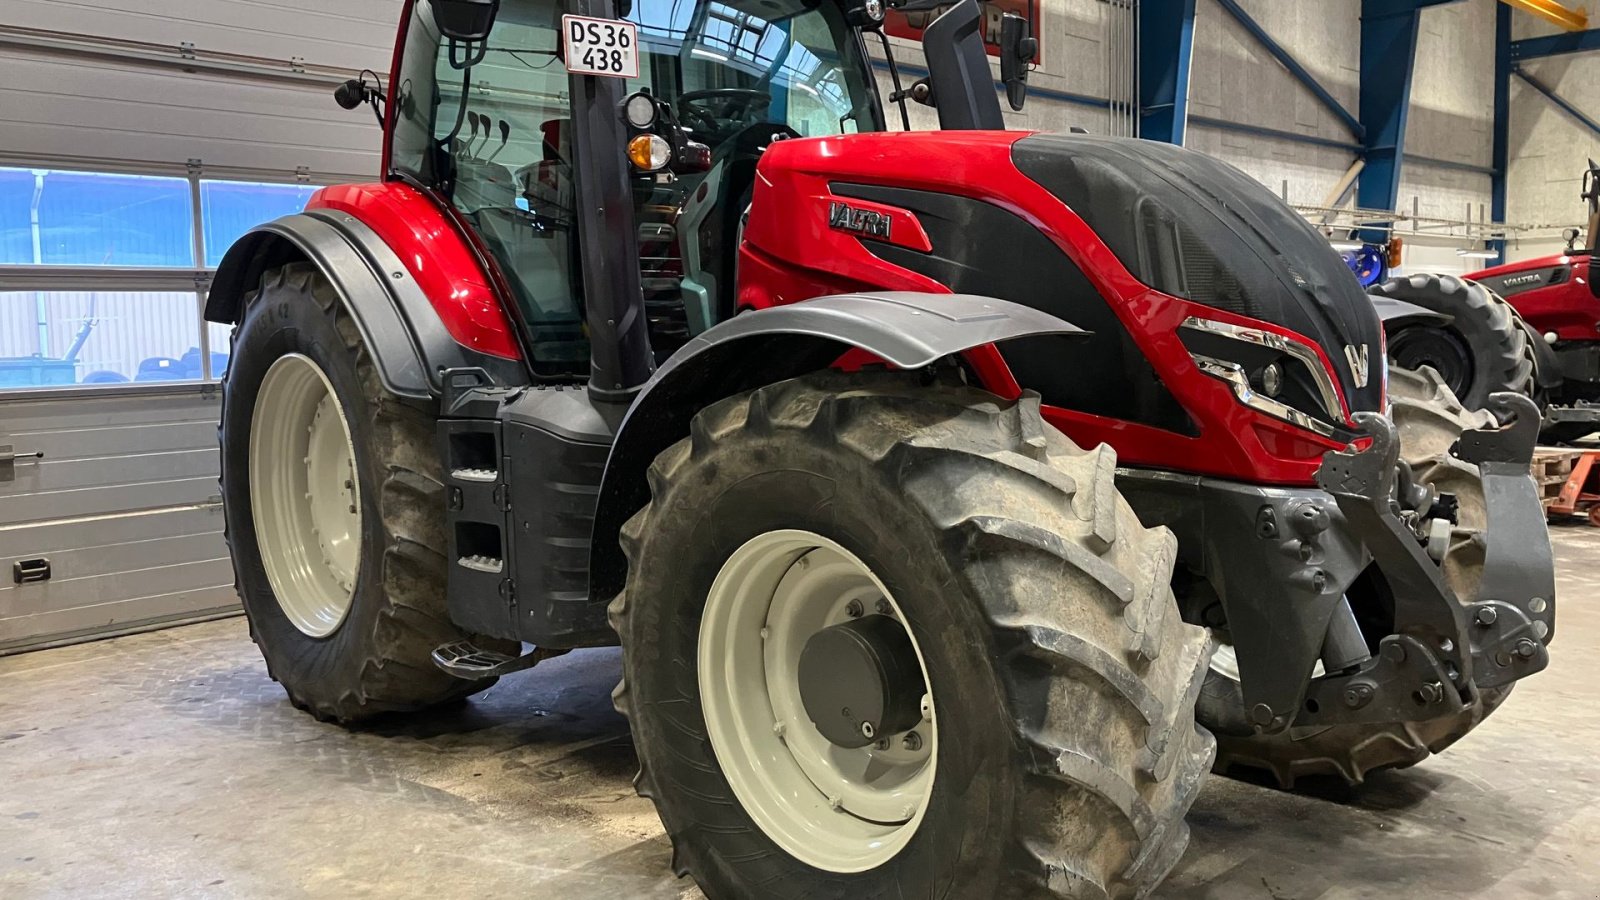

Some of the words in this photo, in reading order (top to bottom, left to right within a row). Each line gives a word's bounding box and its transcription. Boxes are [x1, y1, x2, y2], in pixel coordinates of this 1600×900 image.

[570, 21, 630, 48] DS36
[582, 47, 623, 73] 438
[829, 202, 892, 238] VALTRA
[1503, 273, 1541, 287] VALTRA
